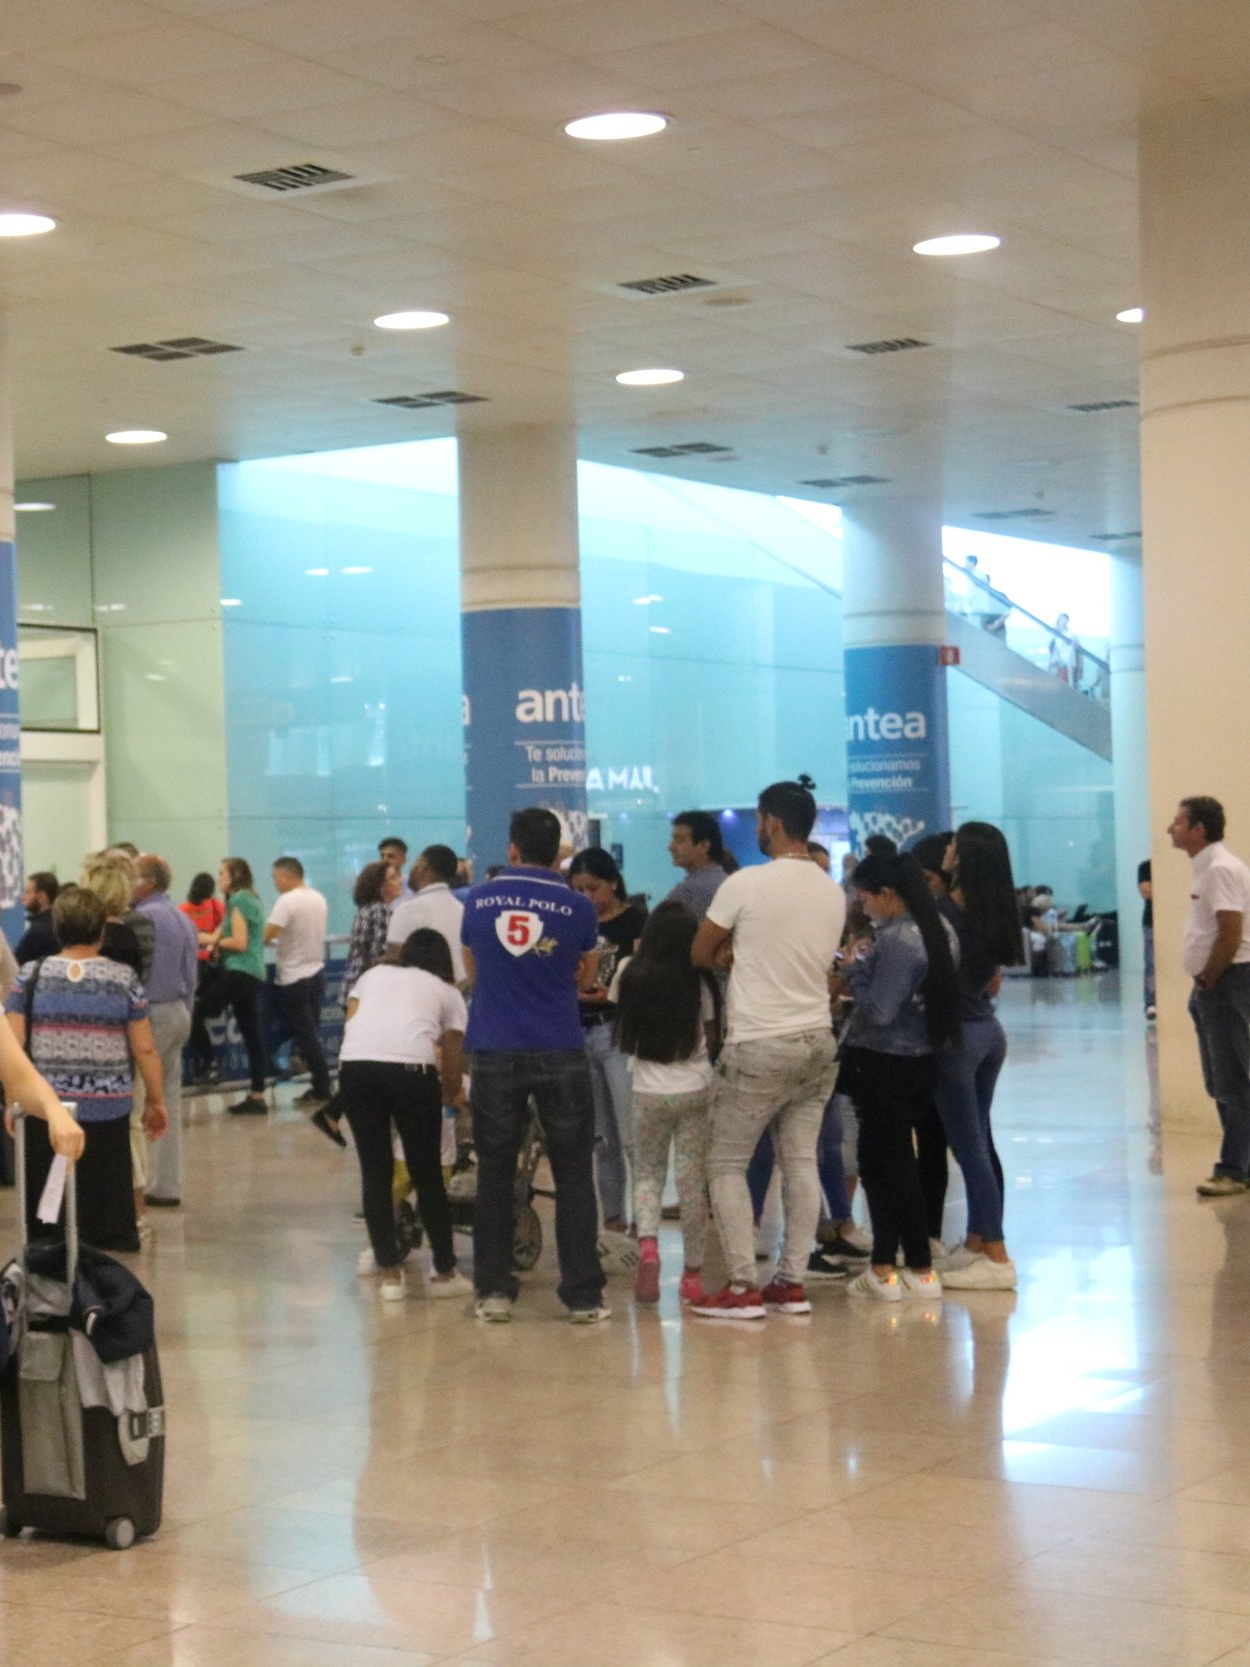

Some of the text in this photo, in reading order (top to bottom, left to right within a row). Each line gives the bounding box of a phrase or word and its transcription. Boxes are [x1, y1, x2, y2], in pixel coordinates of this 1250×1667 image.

[515, 682, 586, 723] ant
[848, 706, 926, 741] ntea
[526, 745, 542, 762] Te
[476, 895, 573, 916] ROYAL POLO
[507, 914, 531, 947] 5
